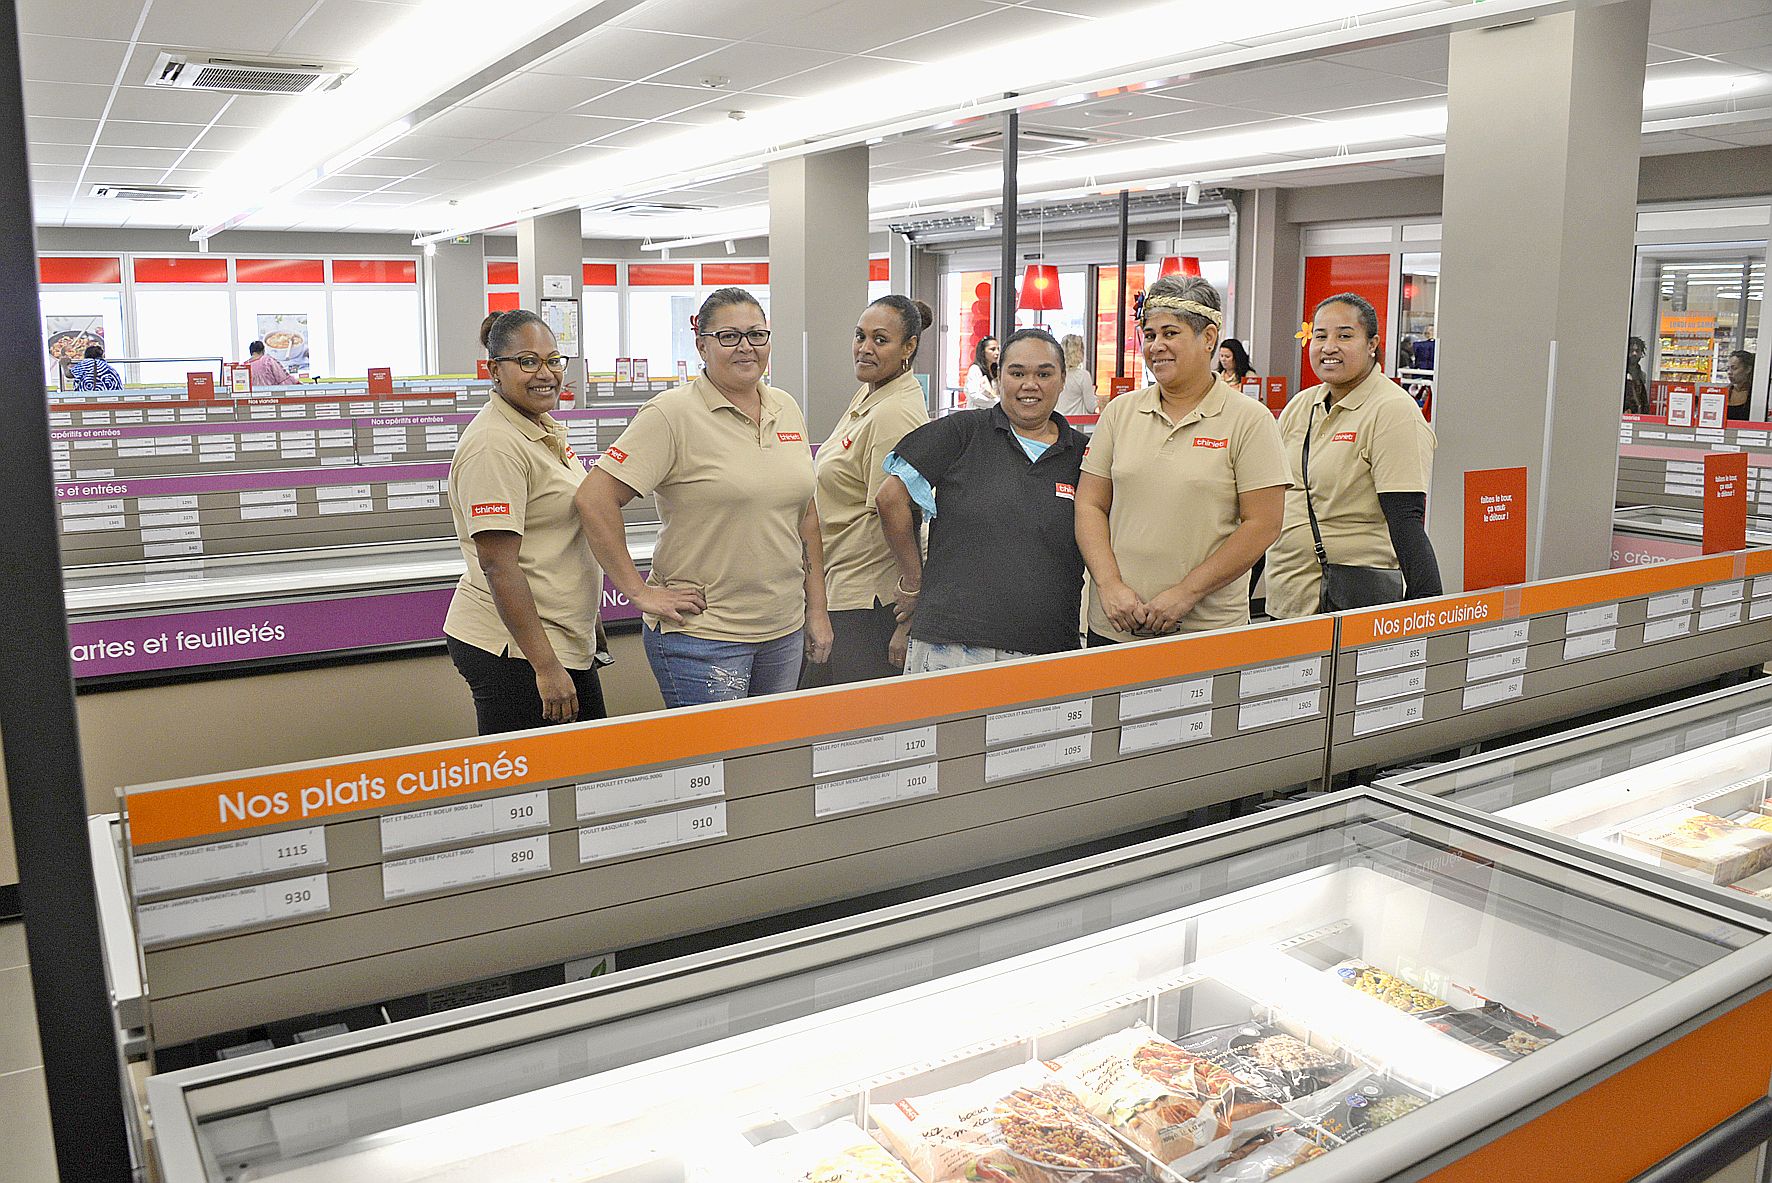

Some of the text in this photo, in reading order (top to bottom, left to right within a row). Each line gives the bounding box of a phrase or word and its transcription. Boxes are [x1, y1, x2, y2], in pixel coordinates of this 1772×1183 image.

[371, 418, 384, 426] Nos
[385, 417, 411, 426] apéritifs
[421, 416, 444, 424] entrées
[84, 430, 92, 438] et
[67, 485, 80, 496] et
[82, 483, 127, 496] entrées
[1495, 494, 1501, 503] le
[474, 505, 507, 514] thiriet
[1483, 514, 1489, 522] le
[602, 589, 630, 608] No
[1373, 600, 1489, 637] Nos plats cuisinés
[69, 620, 286, 662] artes et feuilletés
[1409, 648, 1420, 658] 895
[1190, 688, 1204, 699] 715
[1298, 700, 1312, 710] 1905
[1067, 710, 1082, 721] 985
[1190, 721, 1204, 732] 760
[905, 739, 926, 751] 1170
[1064, 745, 1082, 756] 1095
[217, 750, 529, 823] Nos plats cuisinés
[596, 779, 617, 790] POULET
[617, 778, 623, 786] ET
[690, 775, 711, 789] 890
[907, 775, 927, 787] 1010
[394, 814, 403, 823] ET
[403, 809, 433, 822] BOULETTE
[433, 807, 453, 818] BOEUF
[454, 804, 469, 814] 900G
[510, 805, 534, 819] 910
[580, 826, 601, 837] POULET
[601, 820, 631, 833] BASQUAISE
[634, 818, 648, 827] 900G
[692, 816, 713, 830] 910
[277, 844, 309, 859] 1115
[511, 849, 535, 864] 890
[409, 858, 418, 867] DE
[418, 854, 436, 865] TERRE
[436, 850, 458, 862] POULET
[284, 889, 312, 905] 930
